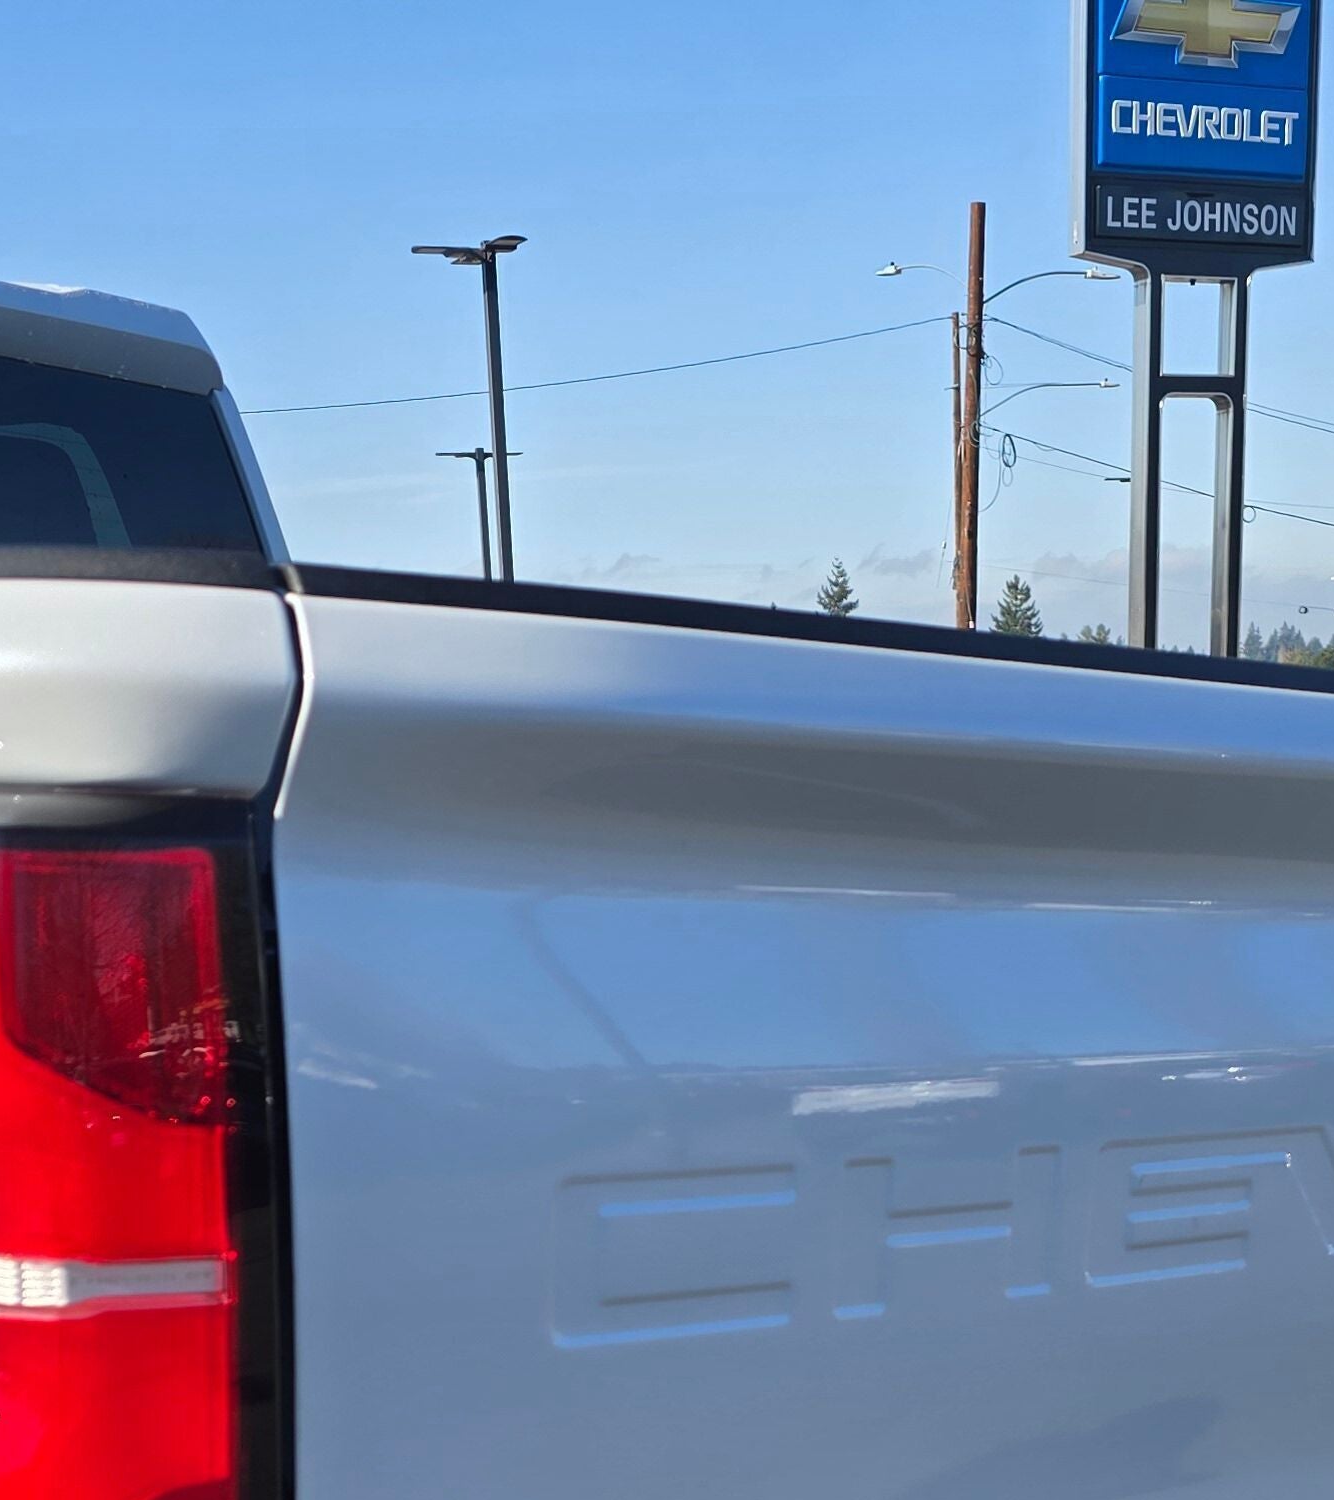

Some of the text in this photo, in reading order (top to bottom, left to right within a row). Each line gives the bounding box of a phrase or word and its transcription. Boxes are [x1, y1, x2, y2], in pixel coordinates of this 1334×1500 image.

[1111, 99, 1300, 146] CHEVROLET
[1106, 196, 1297, 236] LEE JOHNSON
